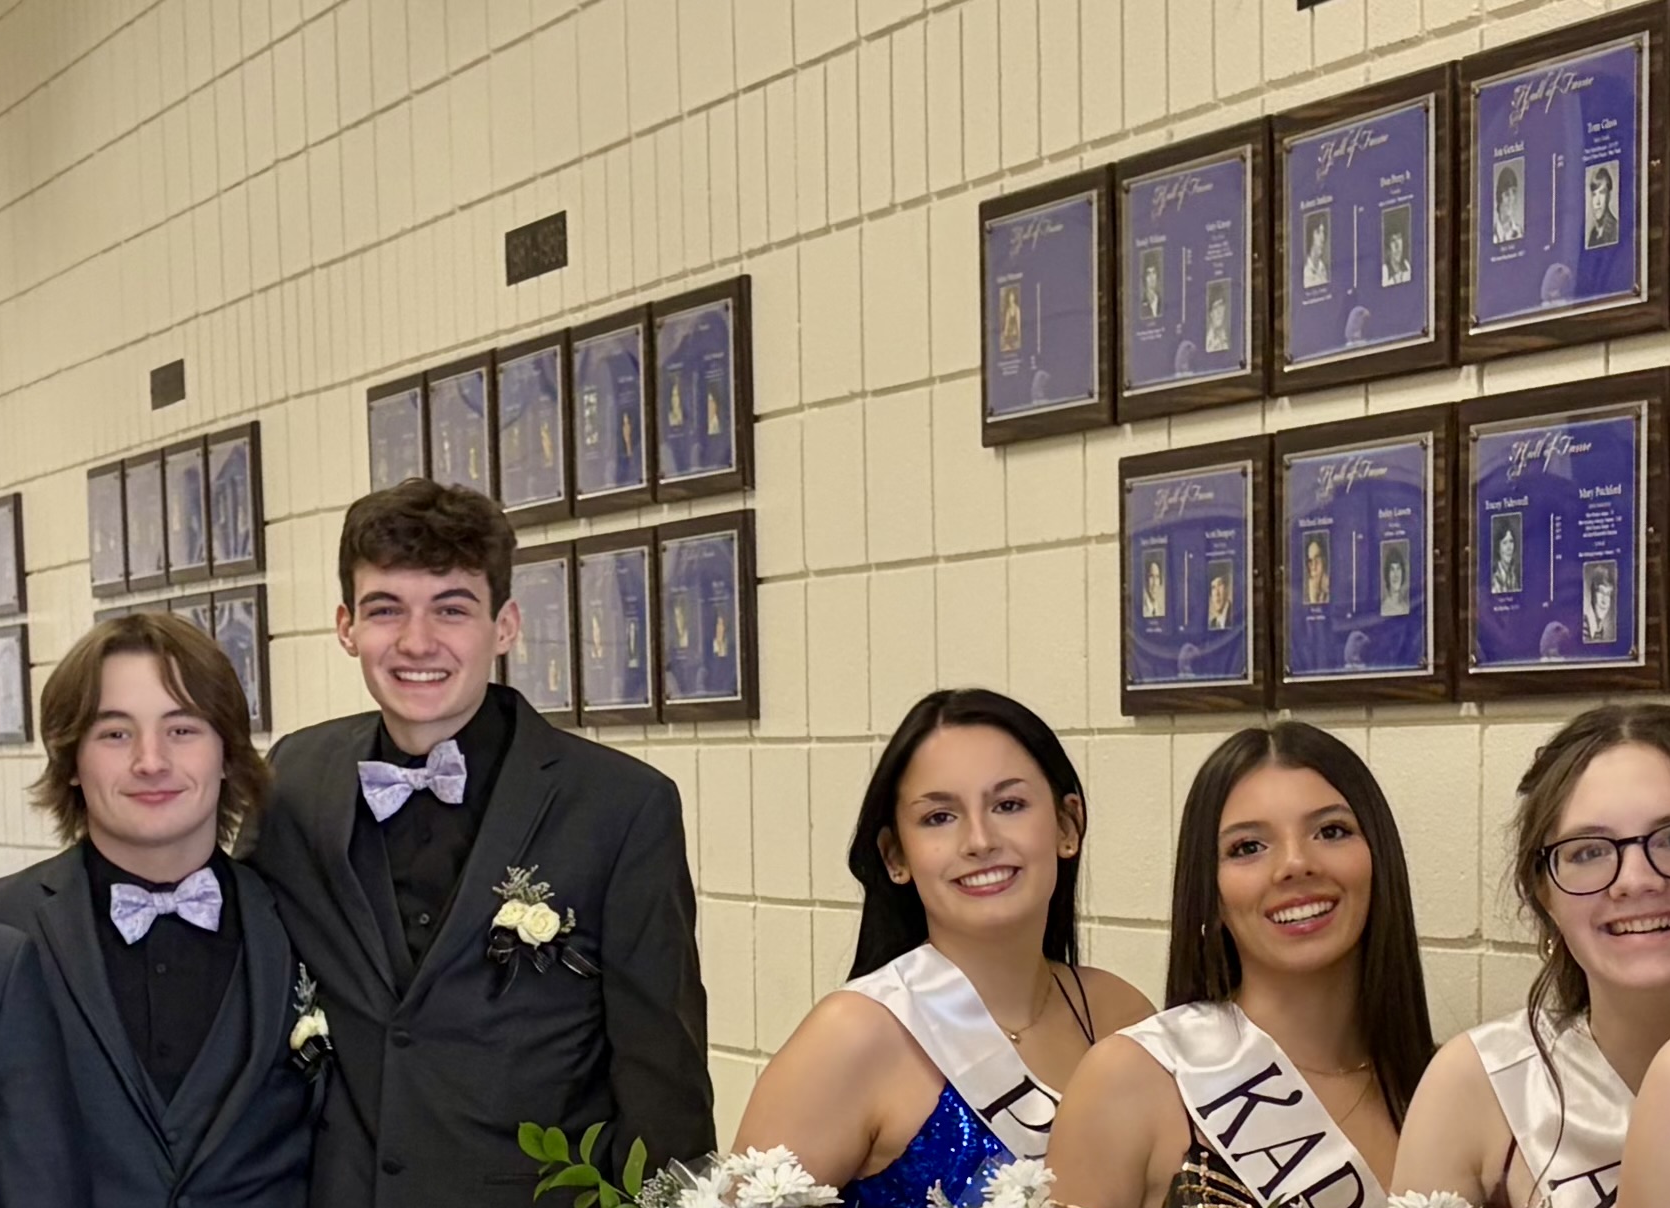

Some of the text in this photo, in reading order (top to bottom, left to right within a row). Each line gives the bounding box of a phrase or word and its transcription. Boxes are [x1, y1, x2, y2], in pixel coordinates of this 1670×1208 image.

[1508, 430, 1592, 478] Hall of Fame
